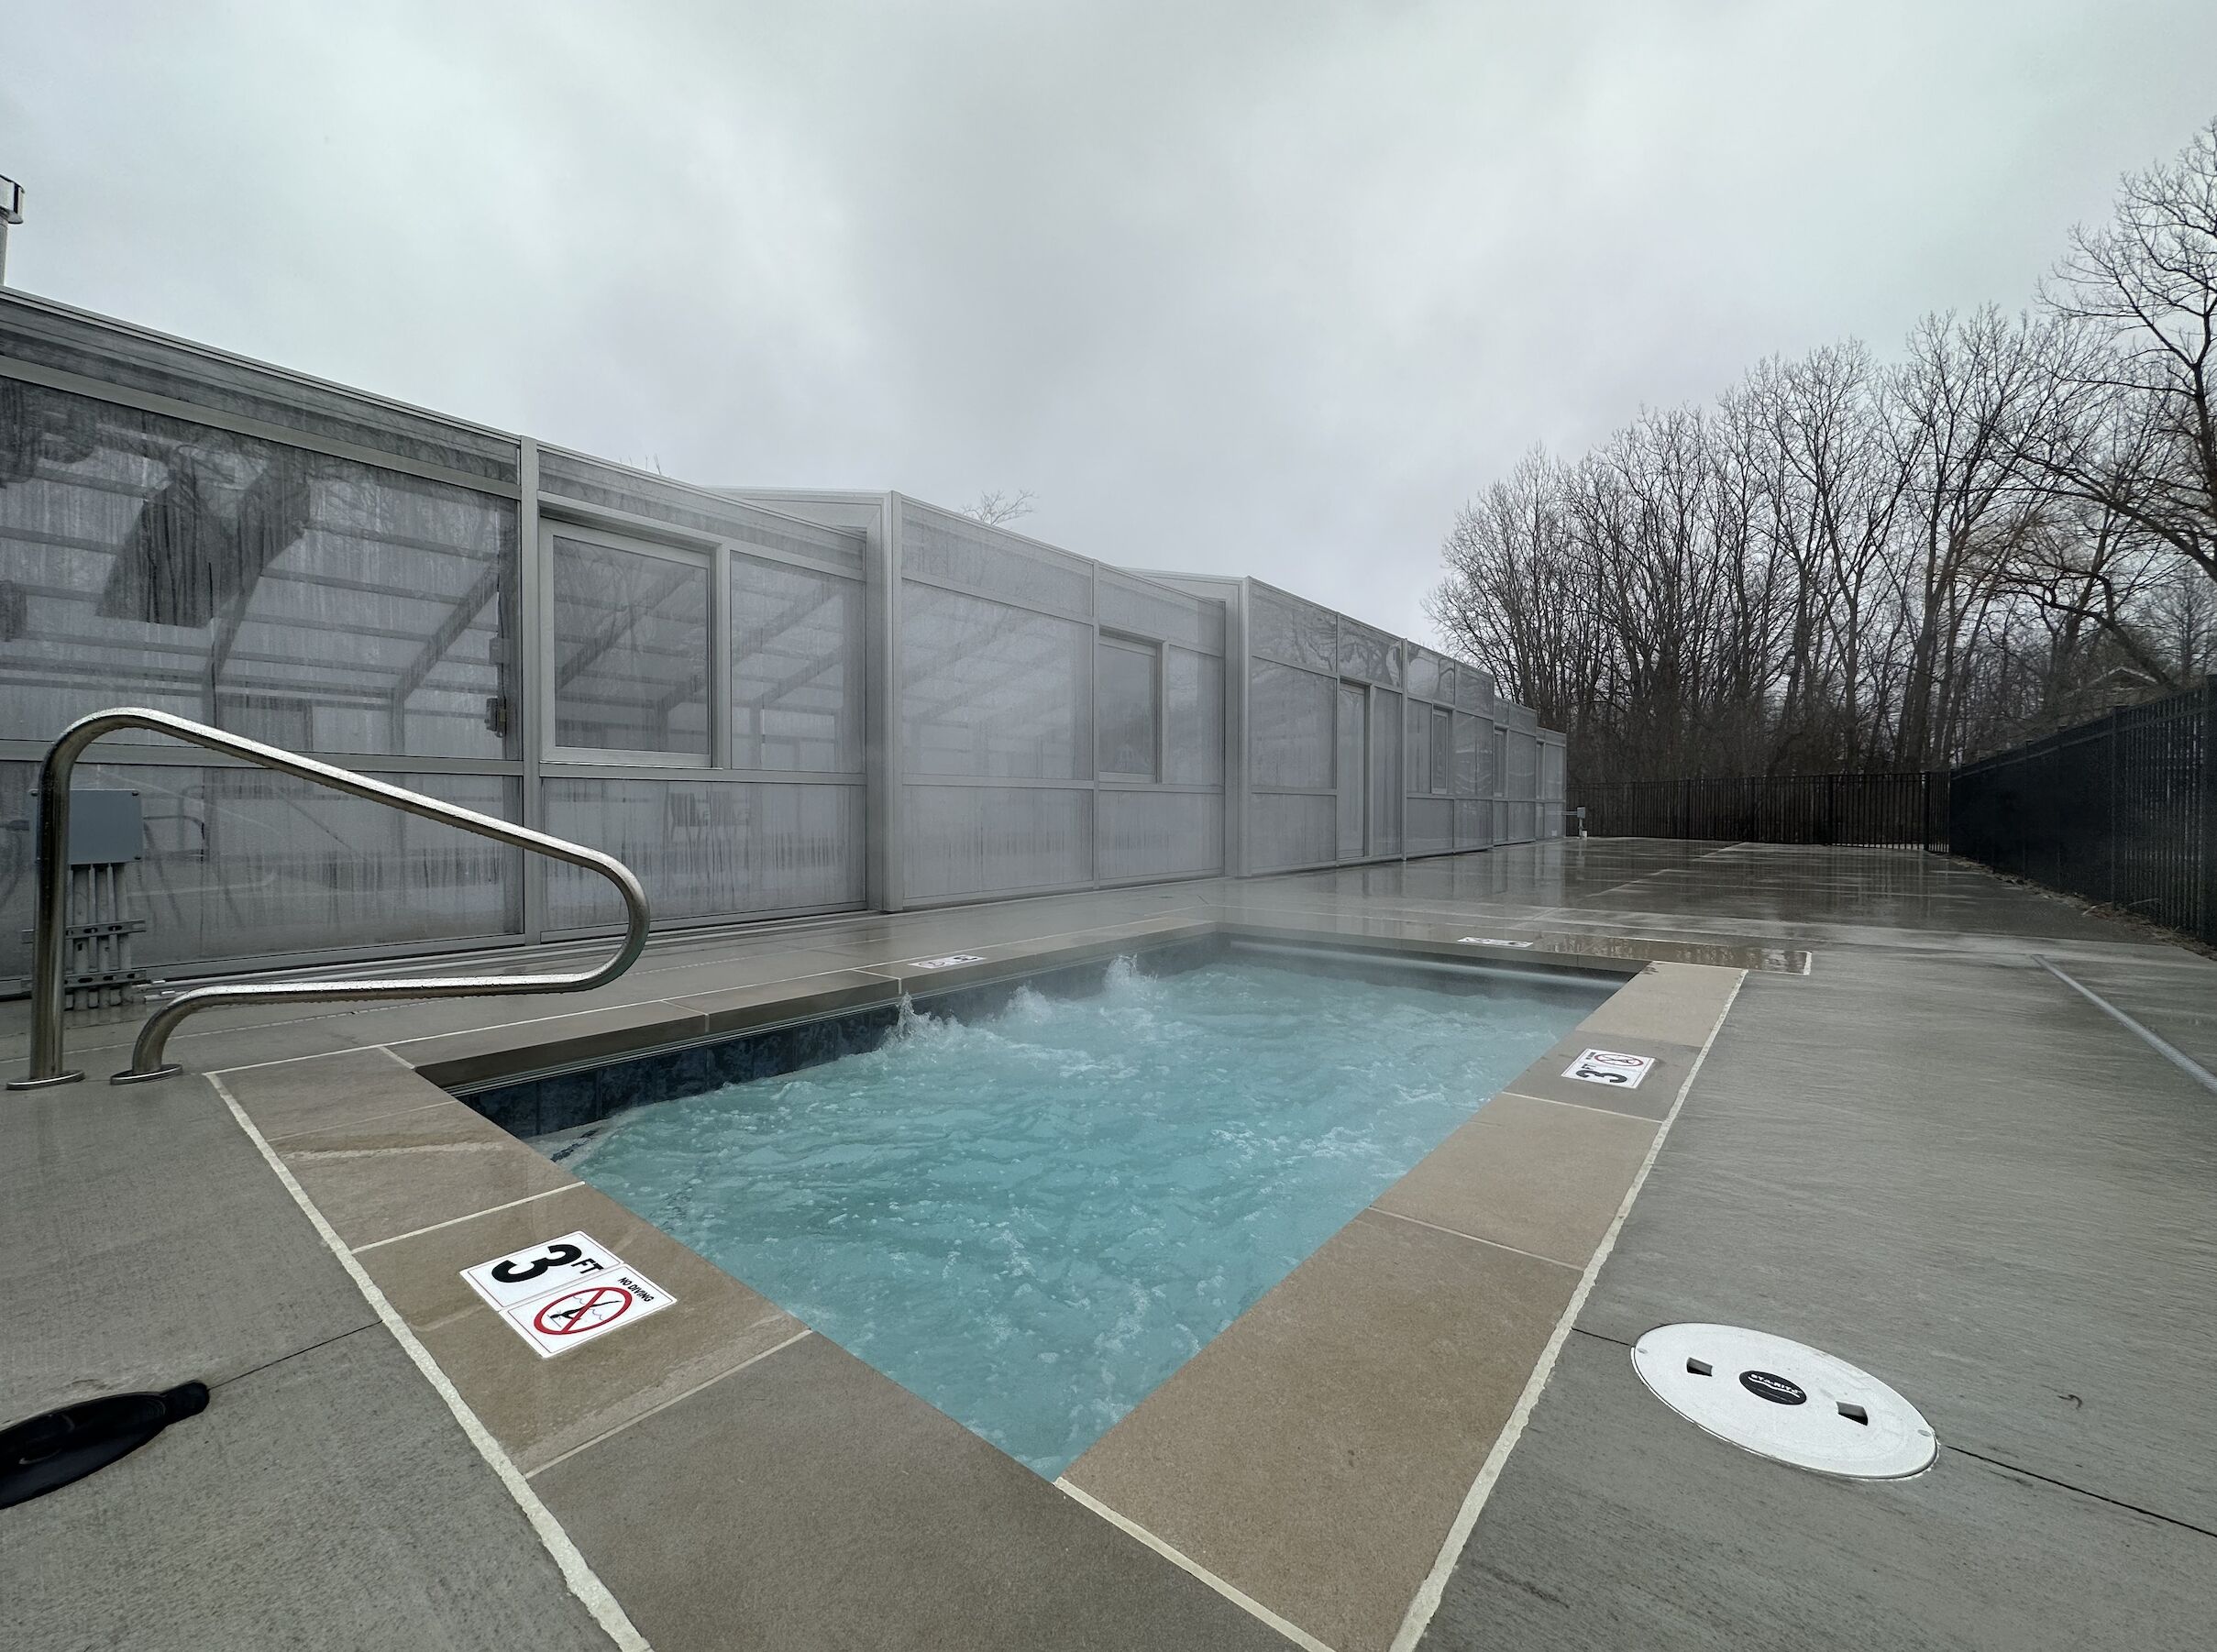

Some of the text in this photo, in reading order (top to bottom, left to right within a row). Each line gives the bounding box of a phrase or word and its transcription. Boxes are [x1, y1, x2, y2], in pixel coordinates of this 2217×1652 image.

[1575, 1069, 1628, 1084] 3
[491, 1243, 604, 1283] 3 FT
[617, 1276, 655, 1303] NO DIVING
